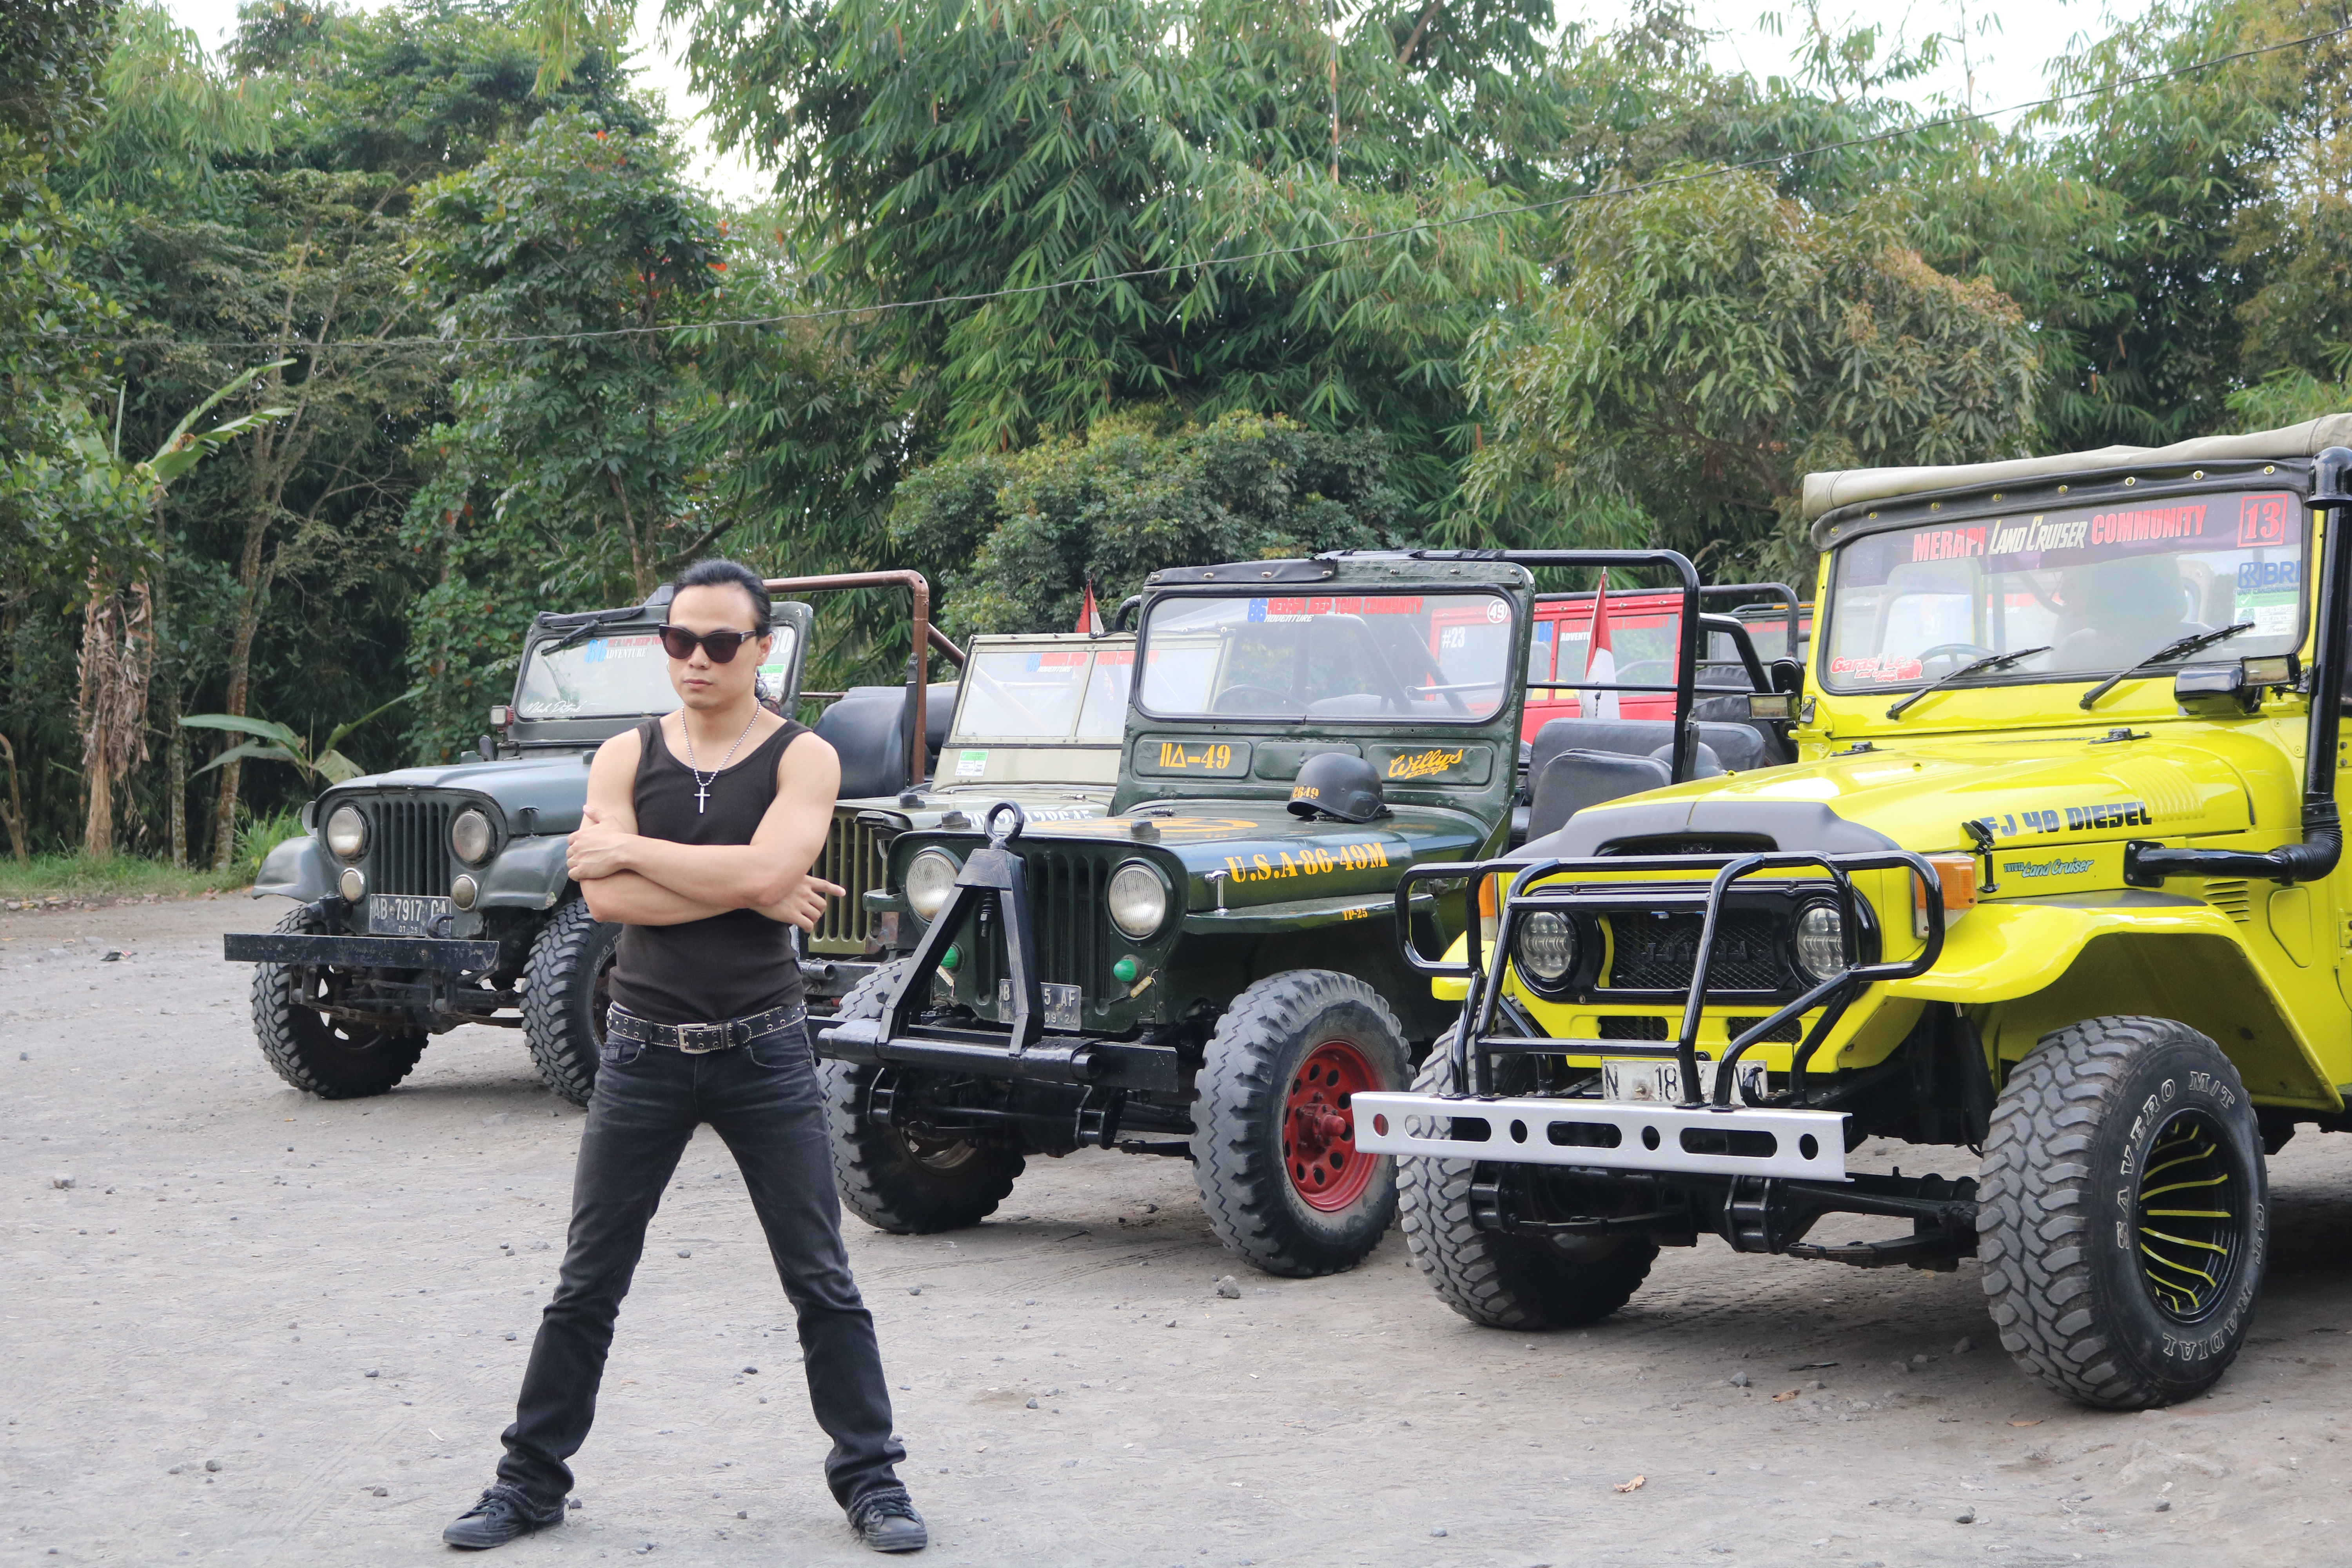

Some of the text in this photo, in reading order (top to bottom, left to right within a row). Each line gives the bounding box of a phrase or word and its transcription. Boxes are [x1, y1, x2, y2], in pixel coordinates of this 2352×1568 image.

[2245, 502, 2281, 539] 13
[1912, 526, 1986, 562] MERAPI
[2026, 515, 2088, 553] CRUISER
[2091, 505, 2207, 544] COMMUNITY
[2263, 560, 2301, 584] BRI
[1247, 596, 1424, 622] 86 MERAPI JEEP TOUR COMMUNITY
[1264, 614, 1314, 623] ADVENTURE
[1490, 603, 1506, 619] 49
[1442, 627, 1465, 648] #23
[1560, 632, 1590, 642] ADVENTU
[584, 639, 608, 663] 86
[604, 648, 647, 659] ADVENTURE
[1831, 653, 1884, 673] Garasi
[1854, 669, 1897, 679] Land Cruiser
[1388, 749, 1463, 778] Willys
[1410, 766, 1445, 777] KNIGHT
[1978, 801, 2152, 836] FJ 40 DIESEL
[1224, 842, 1389, 883] U.S.A-86-49M
[2004, 858, 2094, 878] TOYOTA Land Cruiser
[373, 898, 387, 920] AB
[395, 898, 423, 921] 7917
[1342, 908, 1368, 921] TP-25
[1648, 941, 1748, 961] TOYTA
[1004, 985, 1010, 1001] B
[1061, 990, 1076, 1007] AF
[1605, 1063, 1620, 1100] N
[2116, 1071, 2235, 1250] SAVERO M/T
[2163, 1203, 2265, 1361] GT RADIAL
